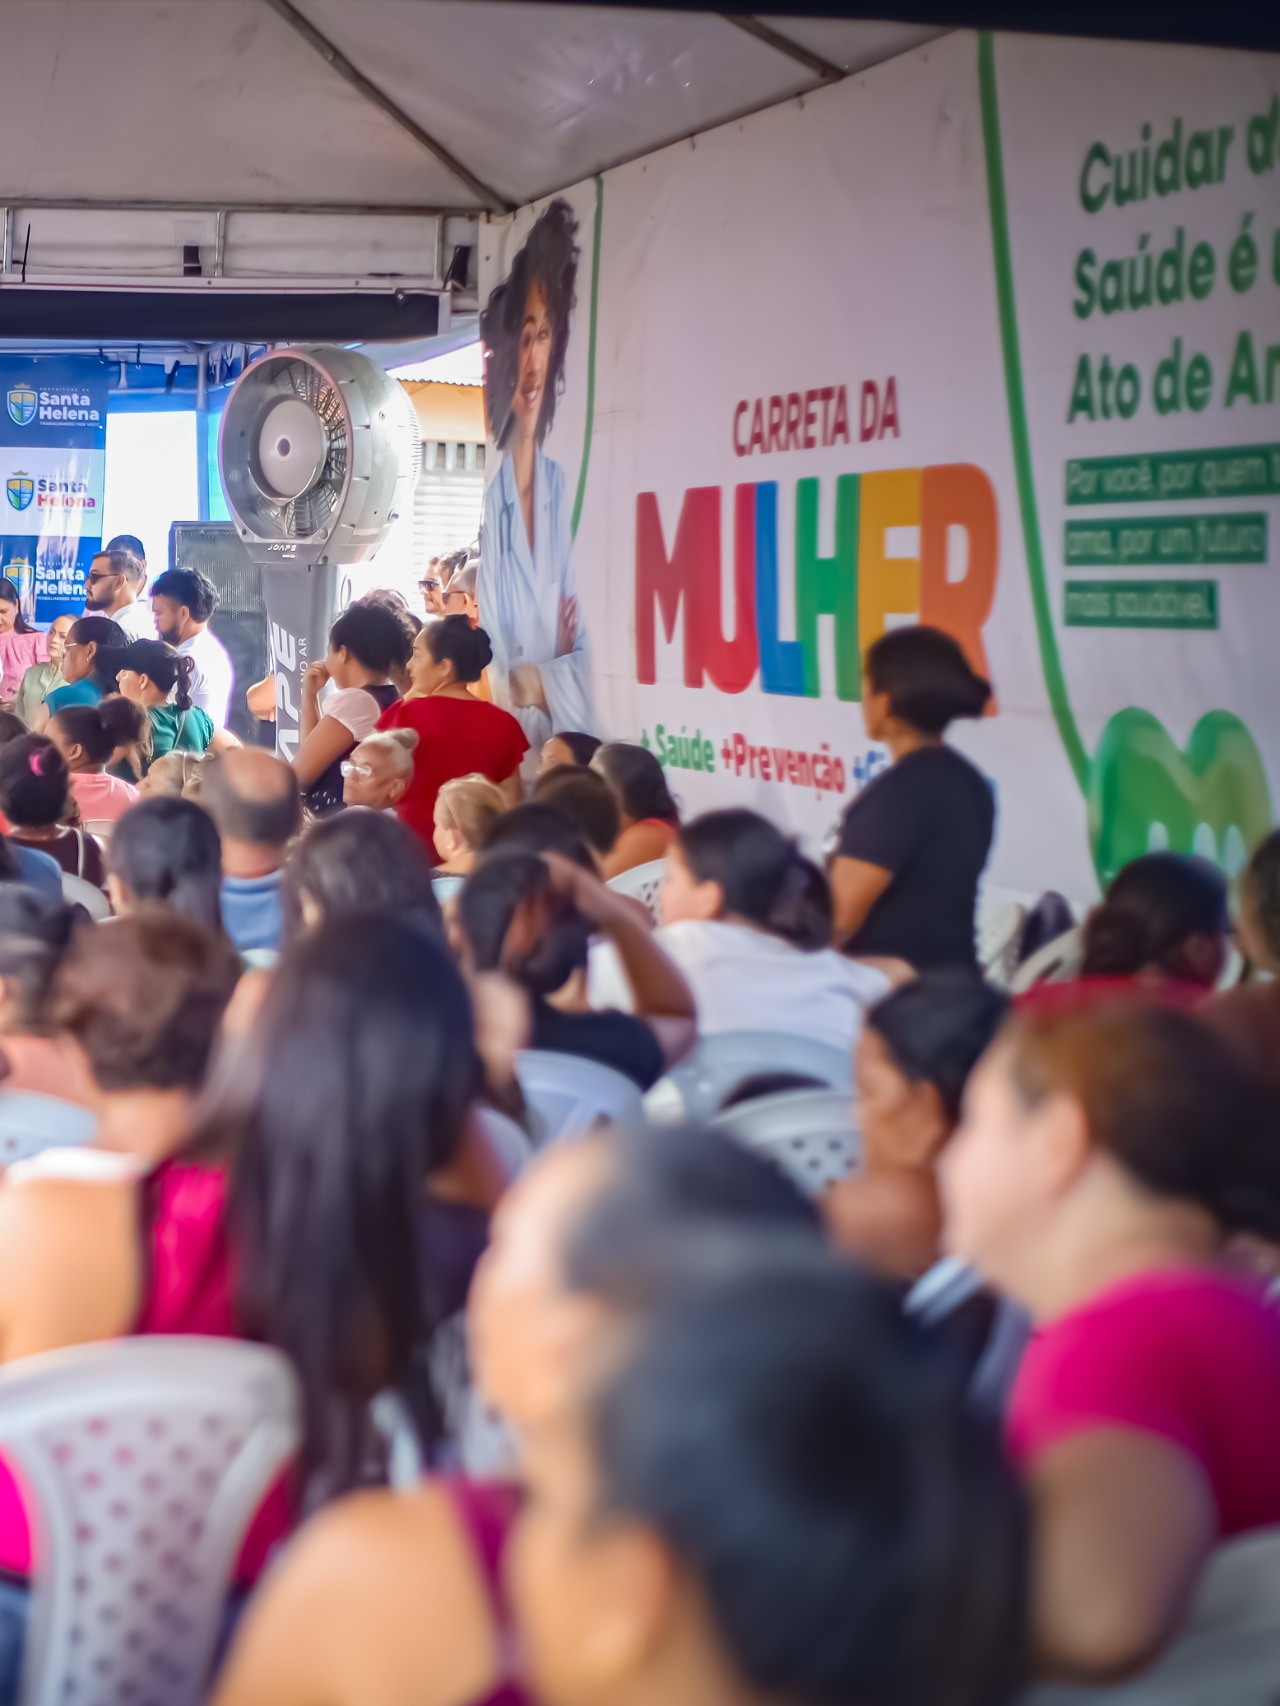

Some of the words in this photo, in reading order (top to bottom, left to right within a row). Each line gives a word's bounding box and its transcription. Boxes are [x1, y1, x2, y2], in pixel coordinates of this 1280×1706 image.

[1079, 115, 1235, 215] Cuidar
[1246, 92, 1280, 177] d
[1073, 225, 1217, 320] Saúde
[1228, 211, 1259, 295] é
[39, 407, 99, 421] Helena
[40, 392, 90, 406] Santa
[732, 384, 850, 457] CARRETA
[859, 375, 901, 444] DA
[1066, 351, 1141, 425] Ato
[1153, 336, 1213, 417] de
[36, 567, 85, 581] Santa
[636, 462, 999, 718] MULHER
[298, 637, 307, 657] AR
[272, 620, 299, 763] APE
